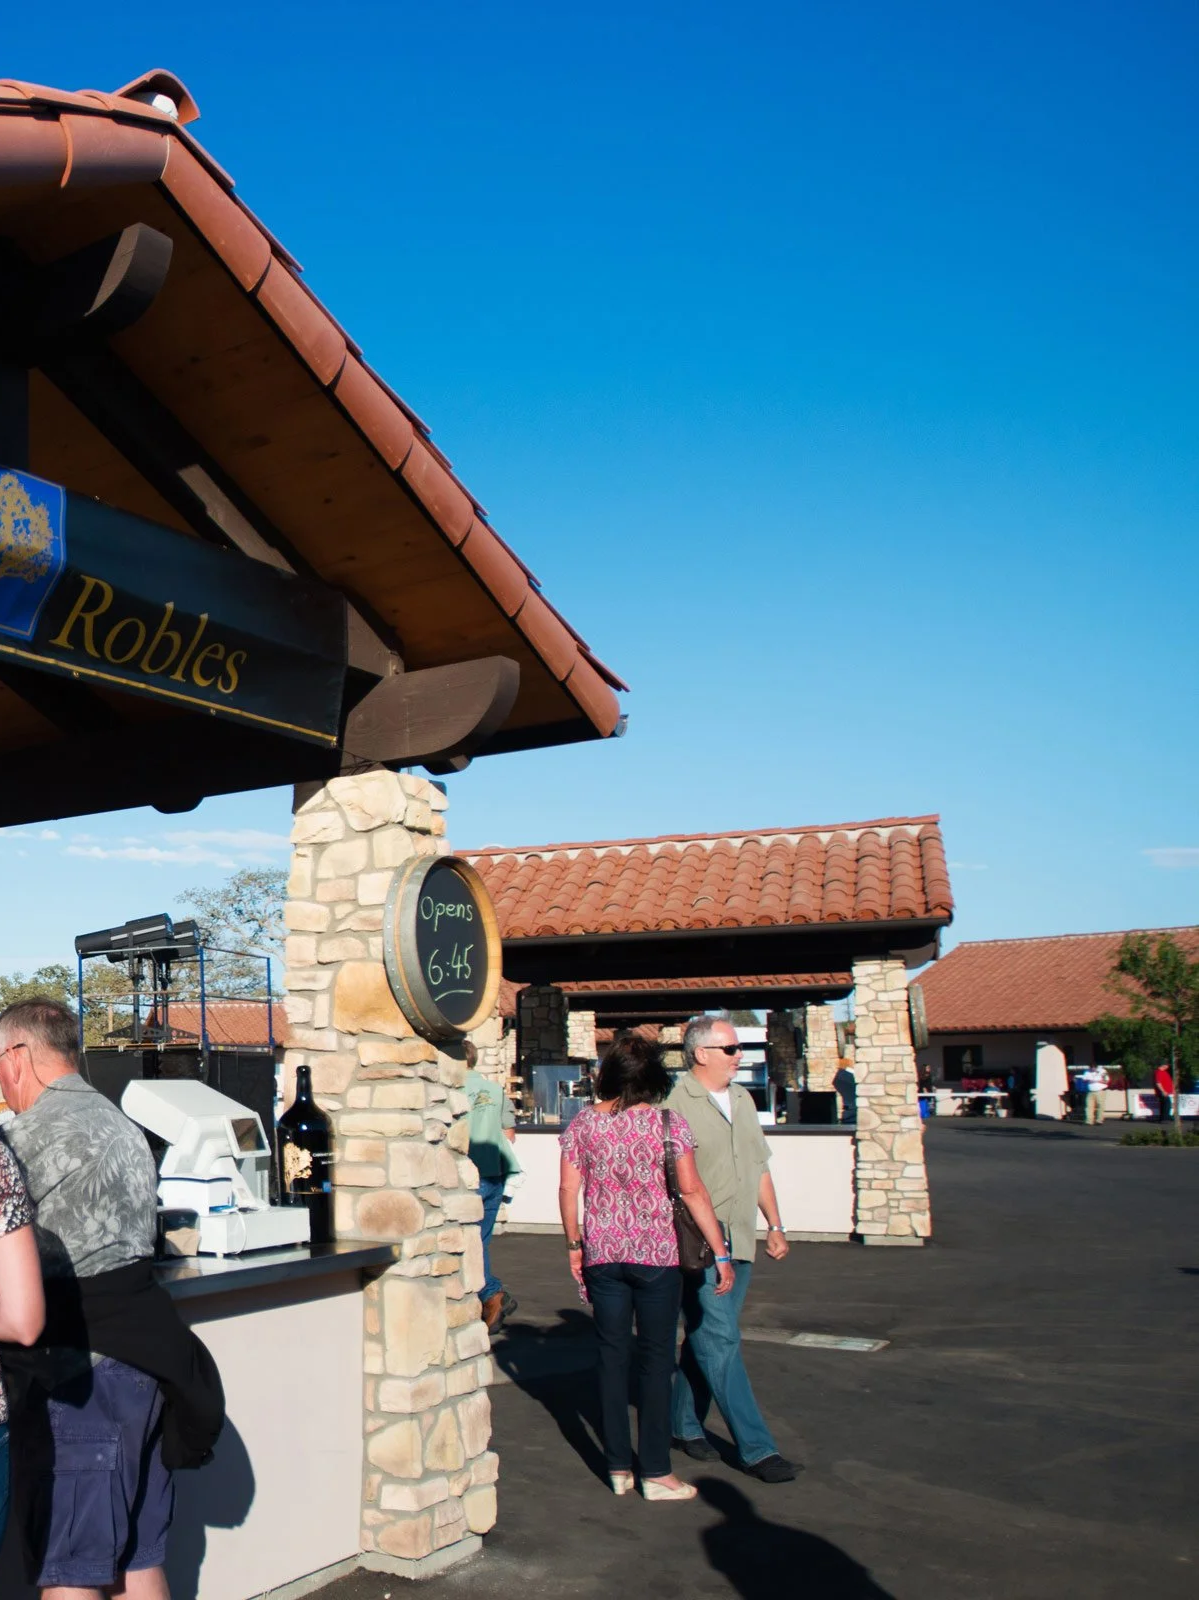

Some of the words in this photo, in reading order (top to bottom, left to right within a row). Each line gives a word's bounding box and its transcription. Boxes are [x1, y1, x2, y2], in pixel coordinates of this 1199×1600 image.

[49, 574, 247, 694] Robles
[420, 896, 473, 932] Opens
[428, 942, 474, 985] 6:45
